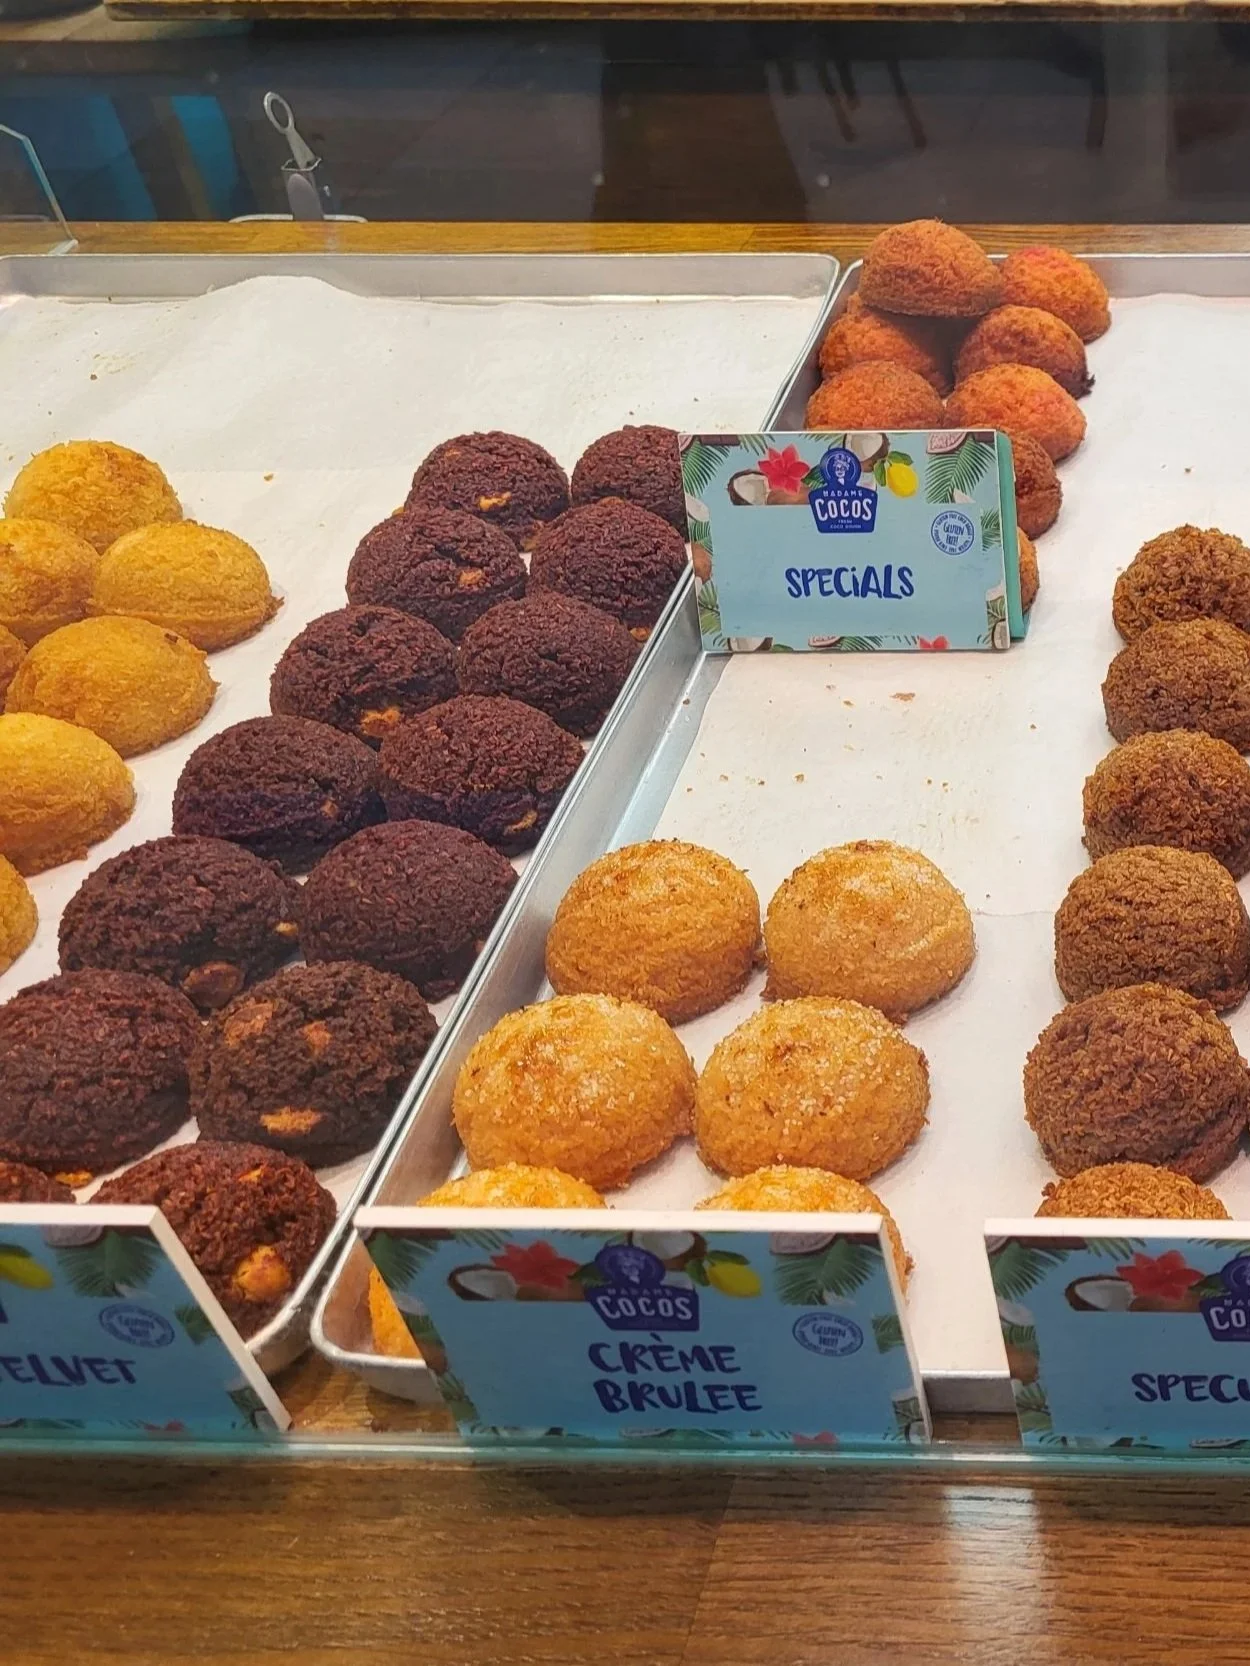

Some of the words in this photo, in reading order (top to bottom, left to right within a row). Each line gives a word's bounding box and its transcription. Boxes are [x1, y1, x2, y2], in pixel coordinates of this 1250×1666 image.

[815, 498, 872, 521] COCOS
[597, 1296, 692, 1320] COCOS
[0, 1353, 136, 1386] ELVET
[588, 1332, 741, 1374] CRÈME
[593, 1379, 762, 1414] BRULEE
